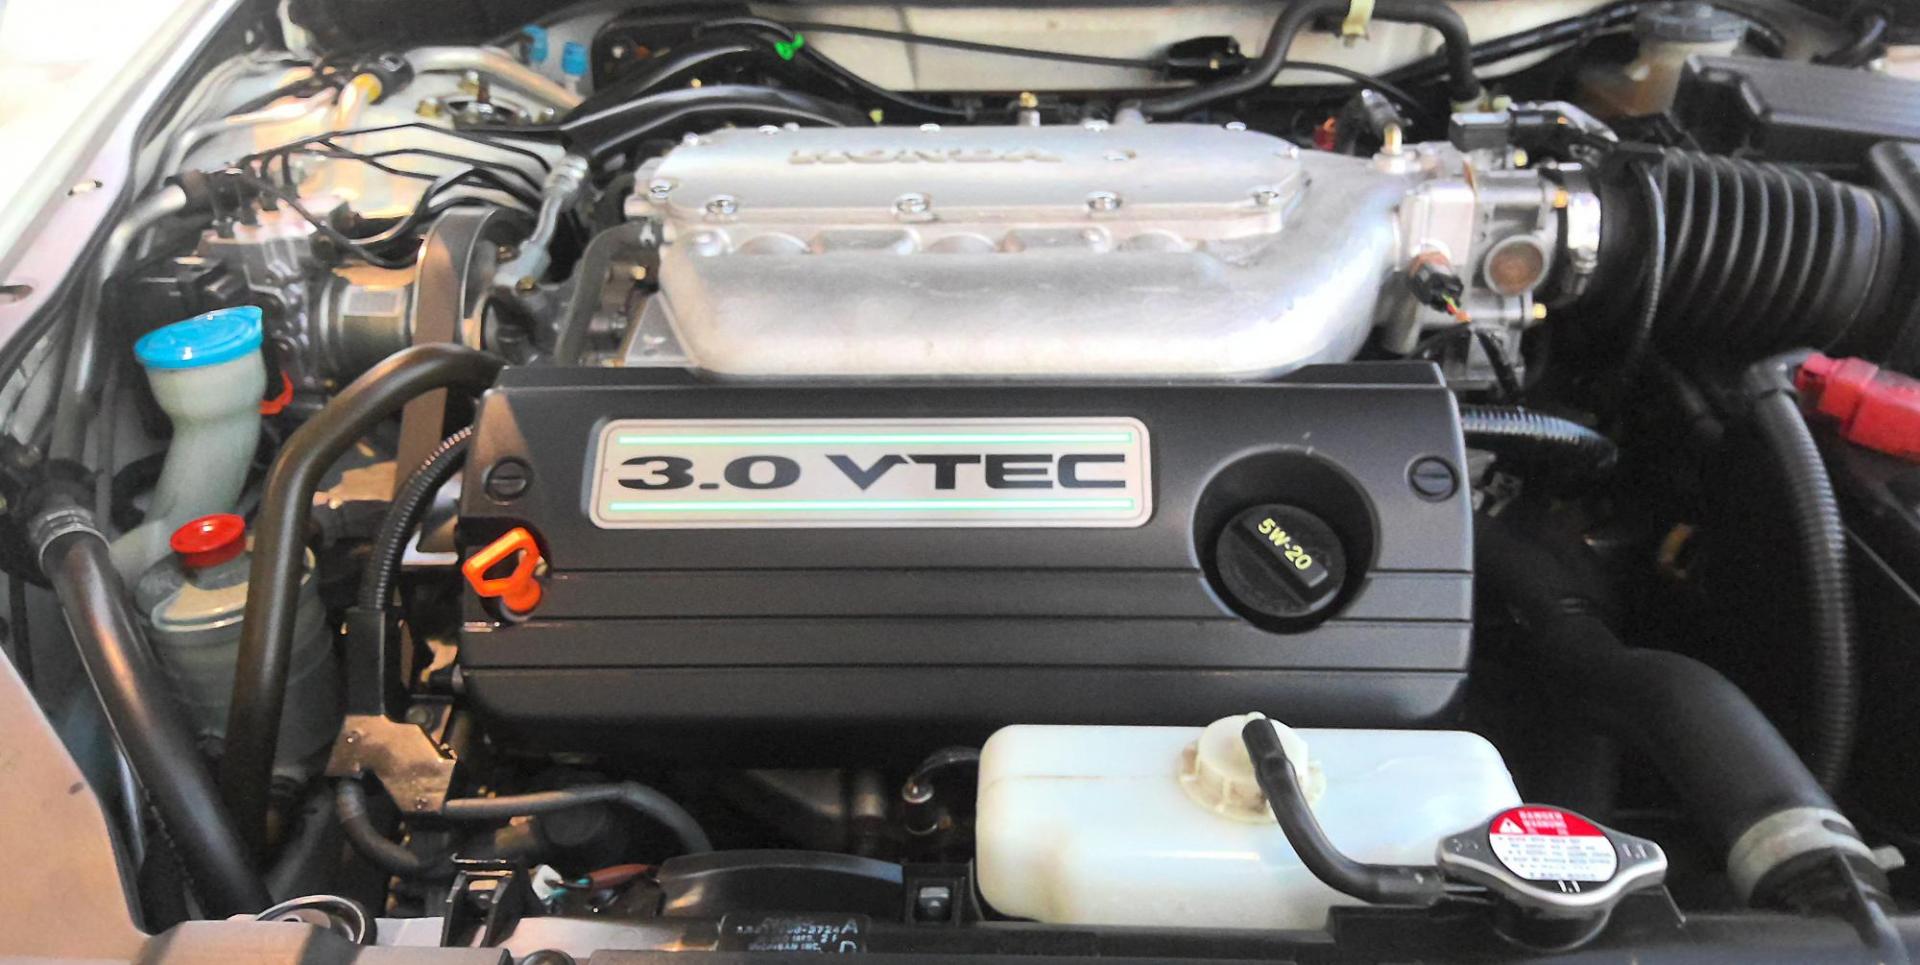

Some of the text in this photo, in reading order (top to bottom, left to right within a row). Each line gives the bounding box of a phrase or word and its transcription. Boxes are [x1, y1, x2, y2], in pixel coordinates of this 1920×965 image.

[618, 454, 1127, 490] 3.0 VTEC
[1258, 518, 1313, 570] 5W-20
